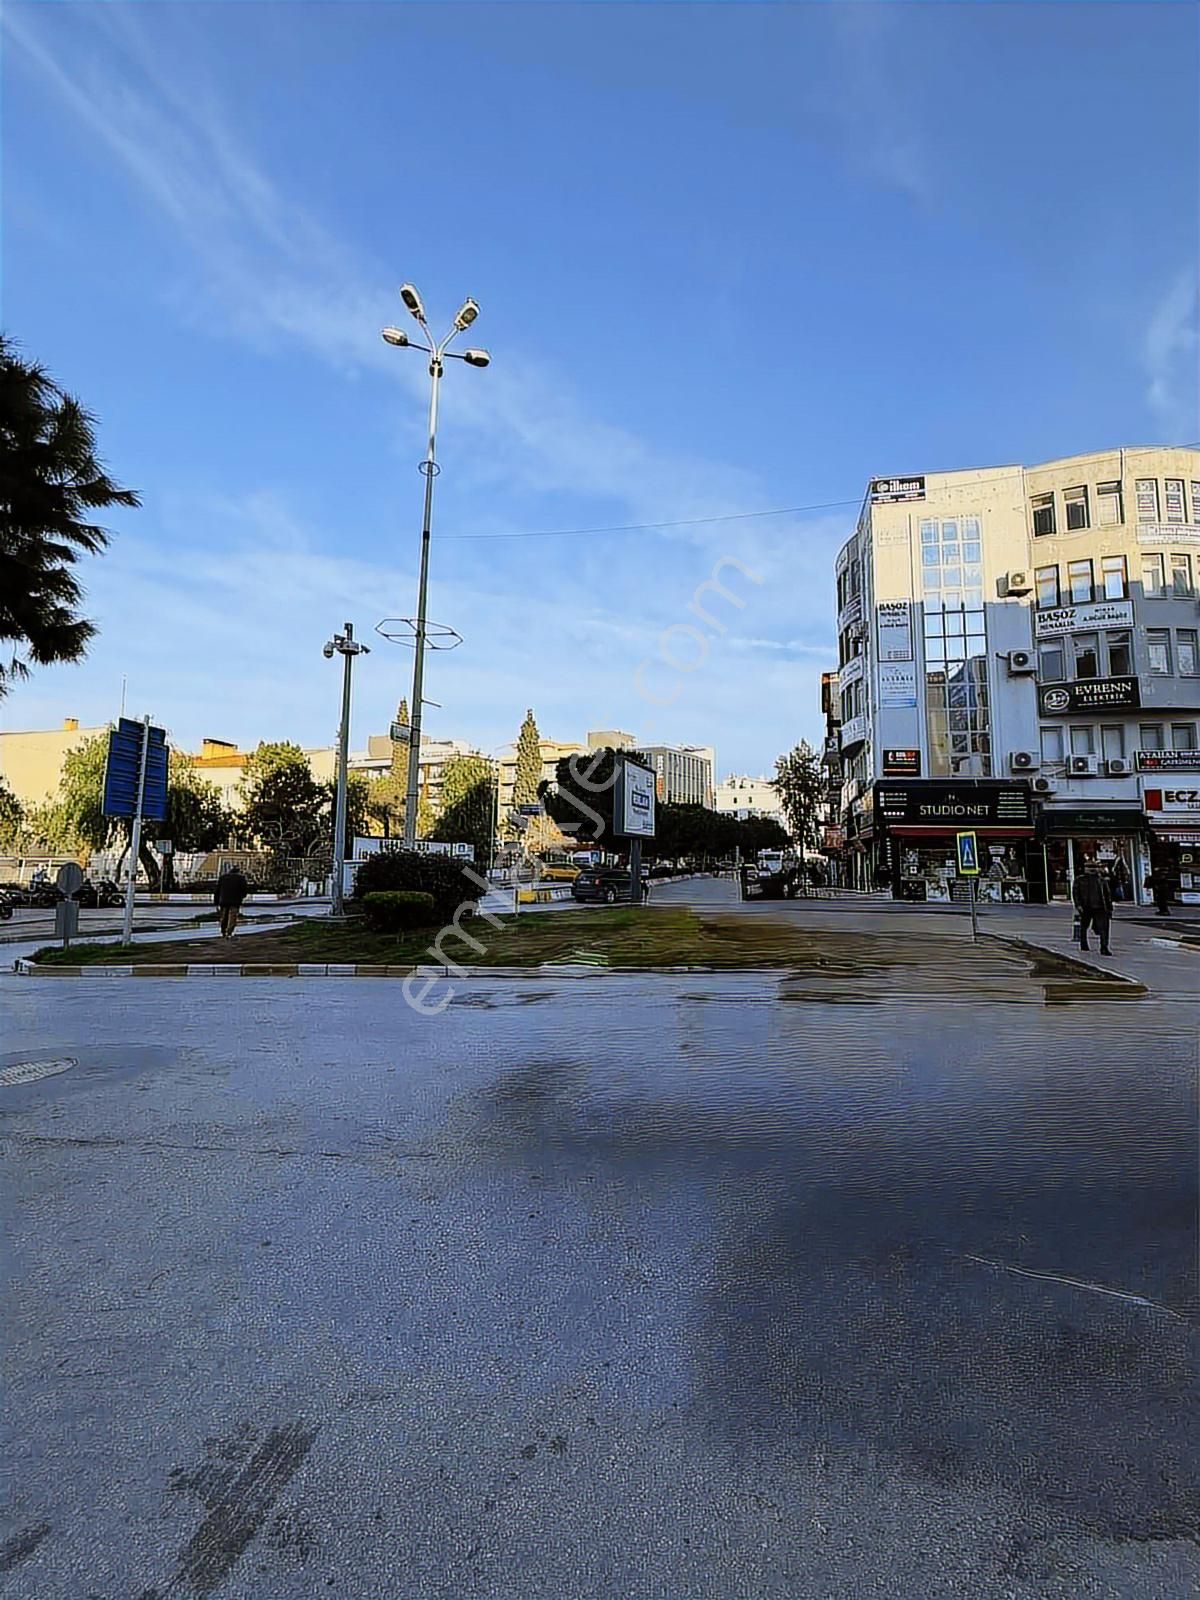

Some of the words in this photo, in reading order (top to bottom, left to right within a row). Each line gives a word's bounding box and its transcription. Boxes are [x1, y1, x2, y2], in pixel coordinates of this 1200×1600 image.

[1074, 682, 1132, 696] EVRENN
[1164, 790, 1200, 803] ECZ
[919, 804, 966, 816] STUDIO
[966, 805, 990, 816] NET
